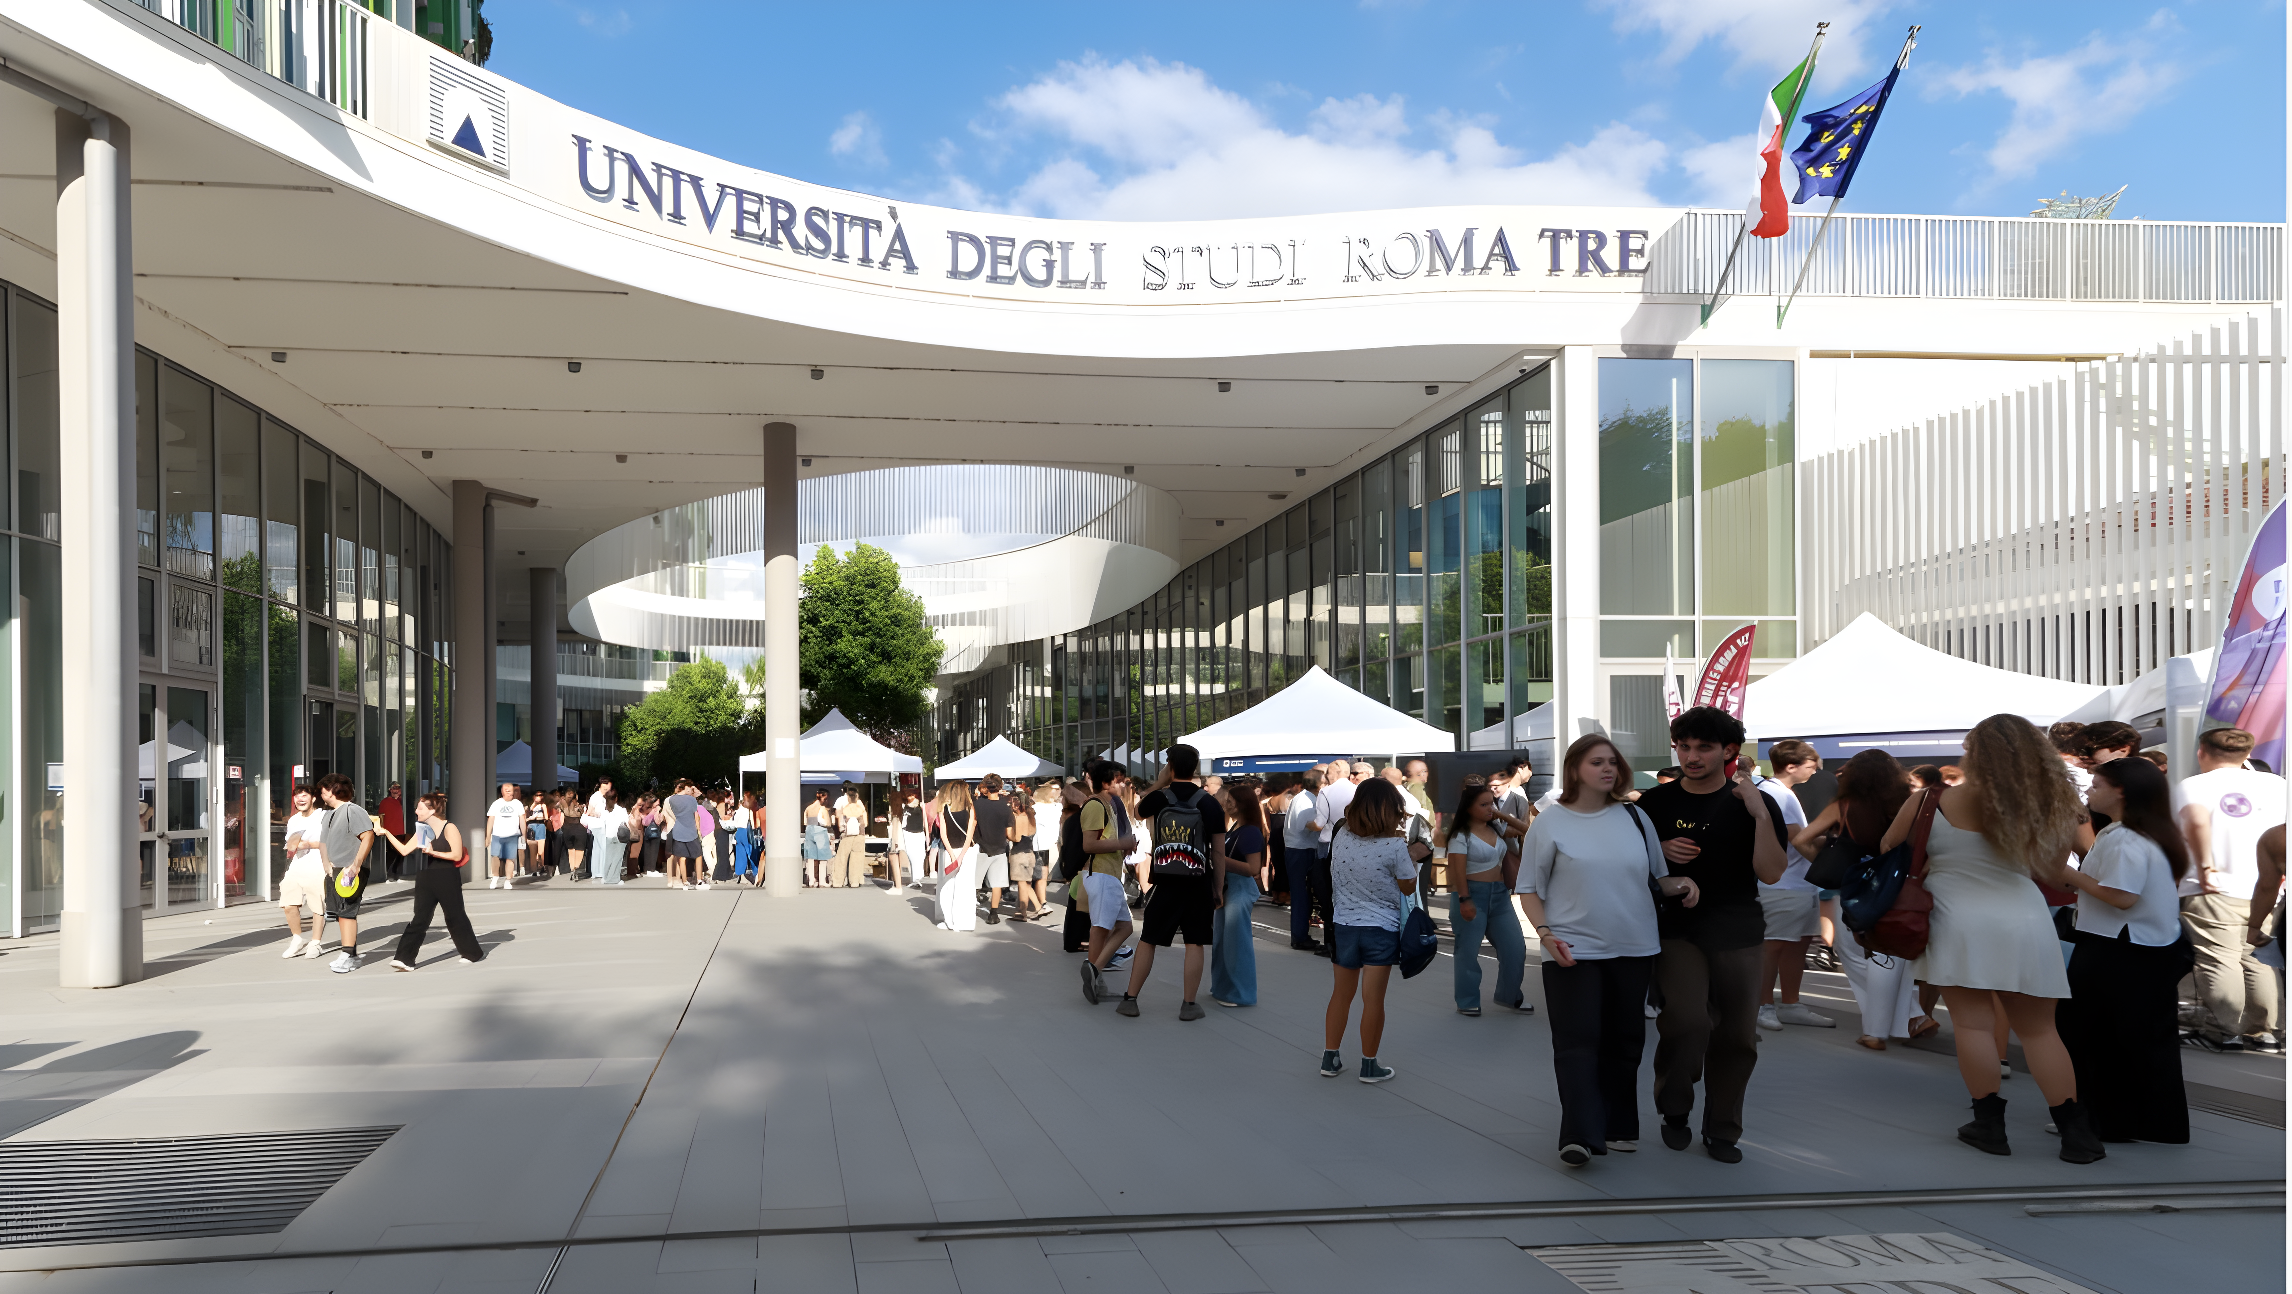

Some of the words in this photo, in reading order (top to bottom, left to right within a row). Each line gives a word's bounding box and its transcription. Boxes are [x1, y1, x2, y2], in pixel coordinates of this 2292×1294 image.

[572, 133, 919, 275] UNIVERSITÀ
[946, 229, 1108, 290] DEGLI
[1142, 239, 1306, 292] STUDI
[1342, 226, 1521, 282] ROMA
[1538, 227, 1651, 279] TRE
[1724, 1234, 2010, 1271] ROMA
